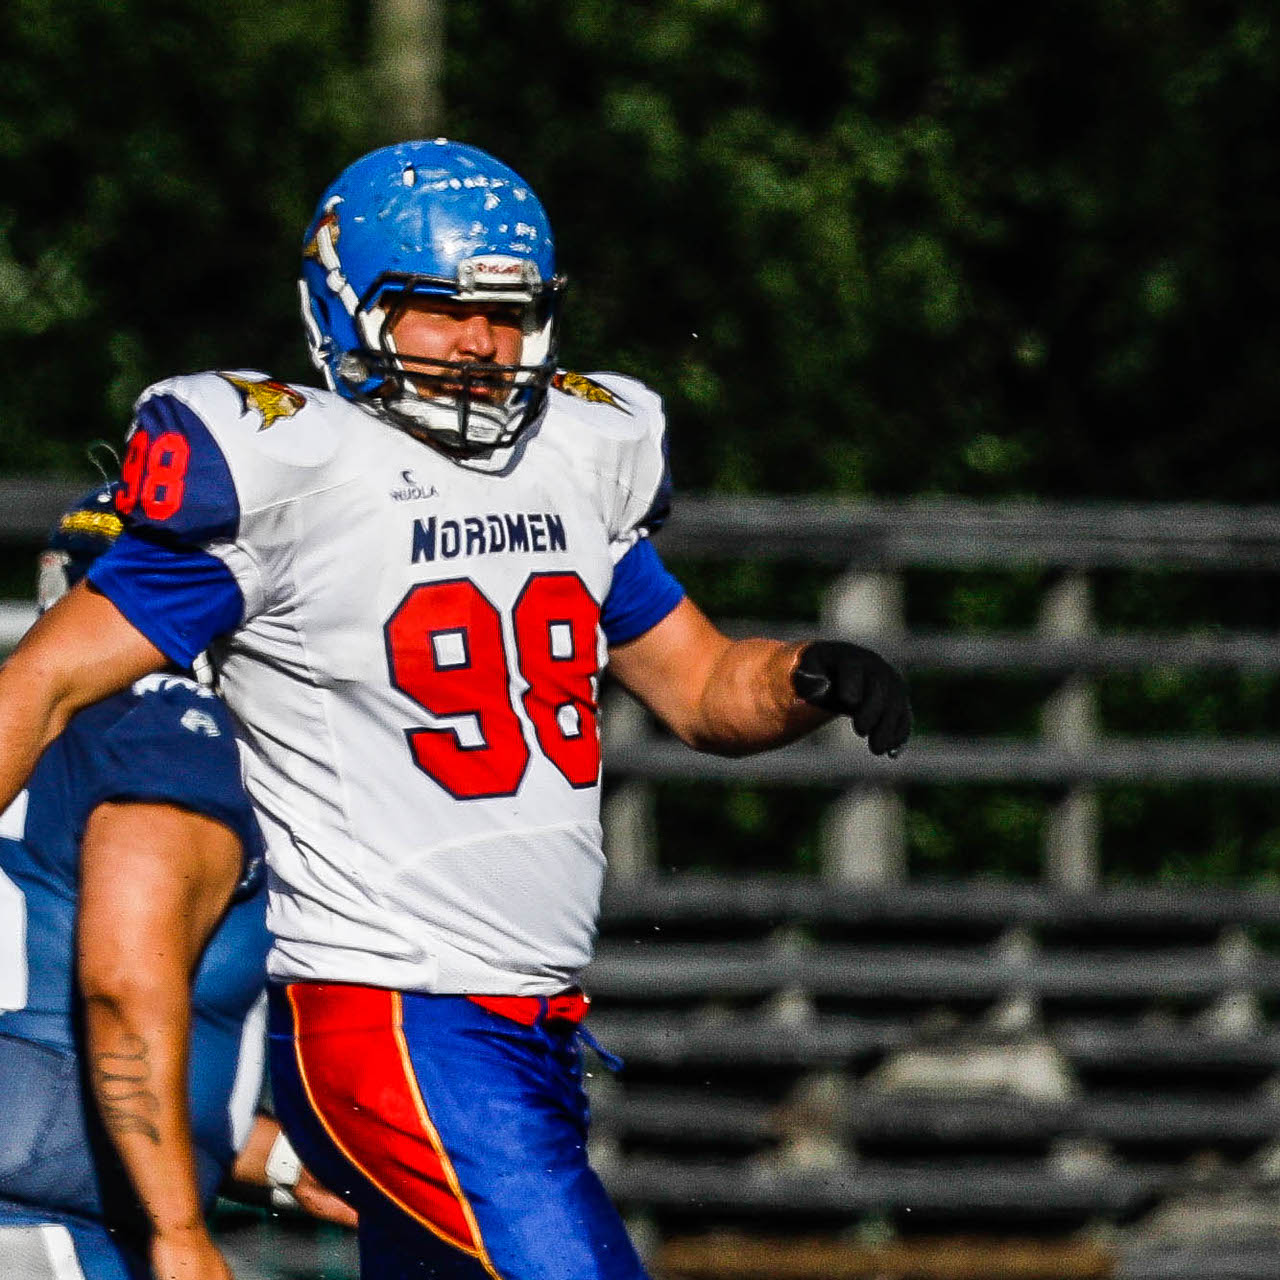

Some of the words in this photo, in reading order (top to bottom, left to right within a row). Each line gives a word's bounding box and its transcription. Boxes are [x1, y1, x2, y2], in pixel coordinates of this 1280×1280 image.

[115, 430, 192, 521] 98
[411, 513, 567, 564] NORDMEN
[383, 571, 601, 801] 98
